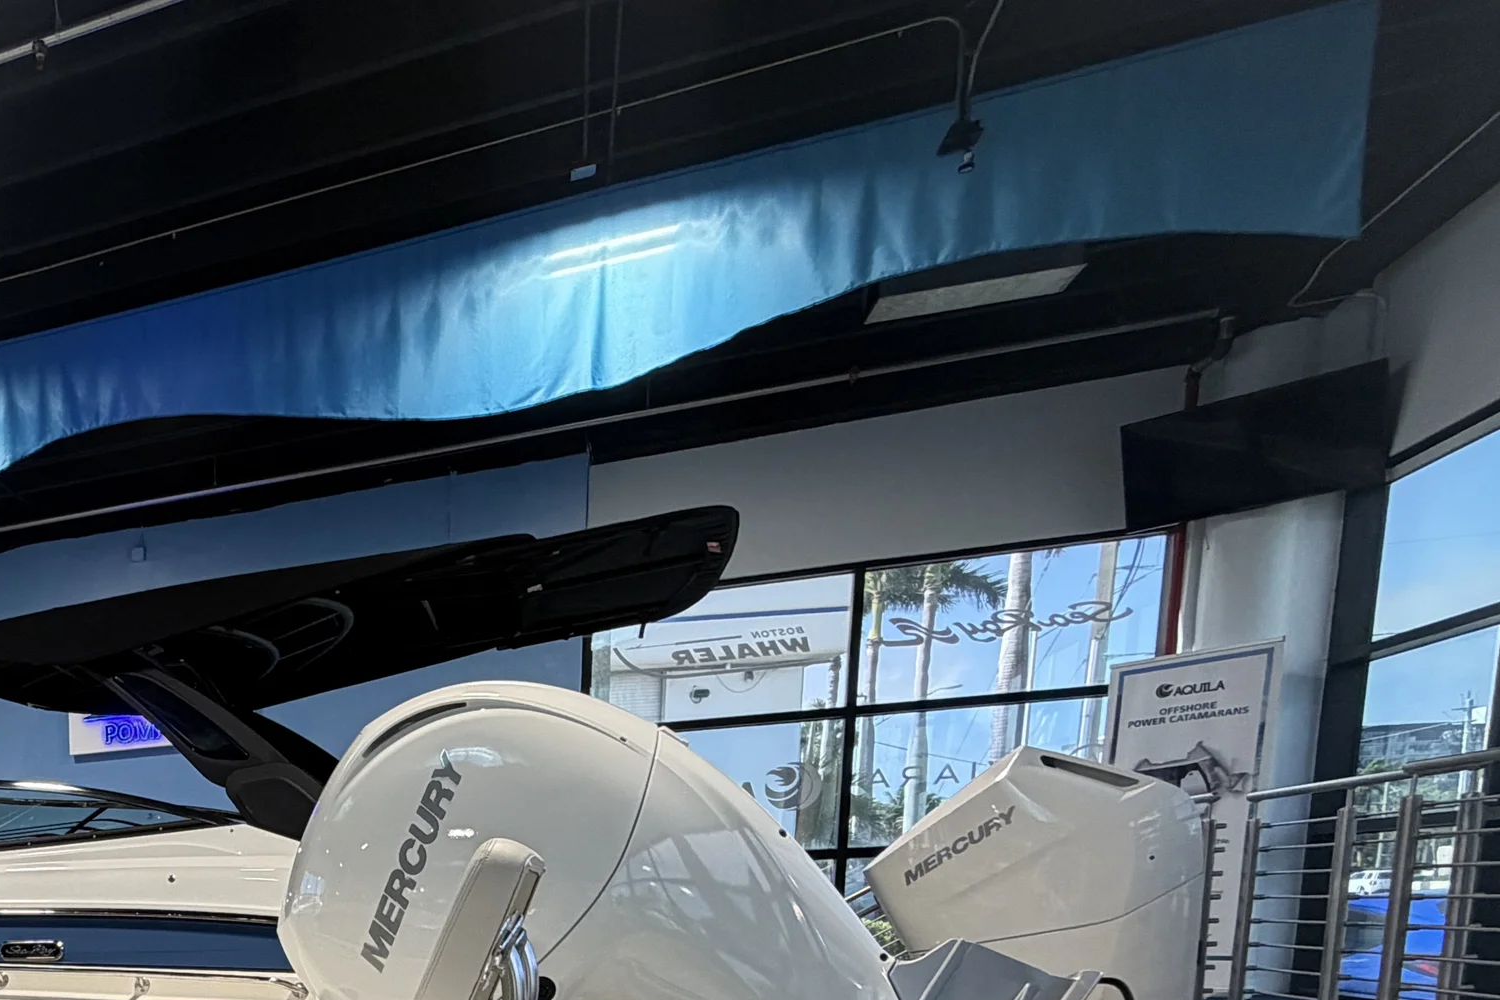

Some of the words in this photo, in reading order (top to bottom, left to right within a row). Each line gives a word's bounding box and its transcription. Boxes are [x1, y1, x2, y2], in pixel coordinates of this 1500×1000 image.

[1173, 680, 1225, 697] AQUILA
[1127, 717, 1167, 729] POWER
[1168, 705, 1251, 724] CATAMARANS
[1158, 701, 1218, 716] OFFSHORE
[903, 805, 1016, 887] MERCURY
[360, 748, 462, 974] MERCURY
